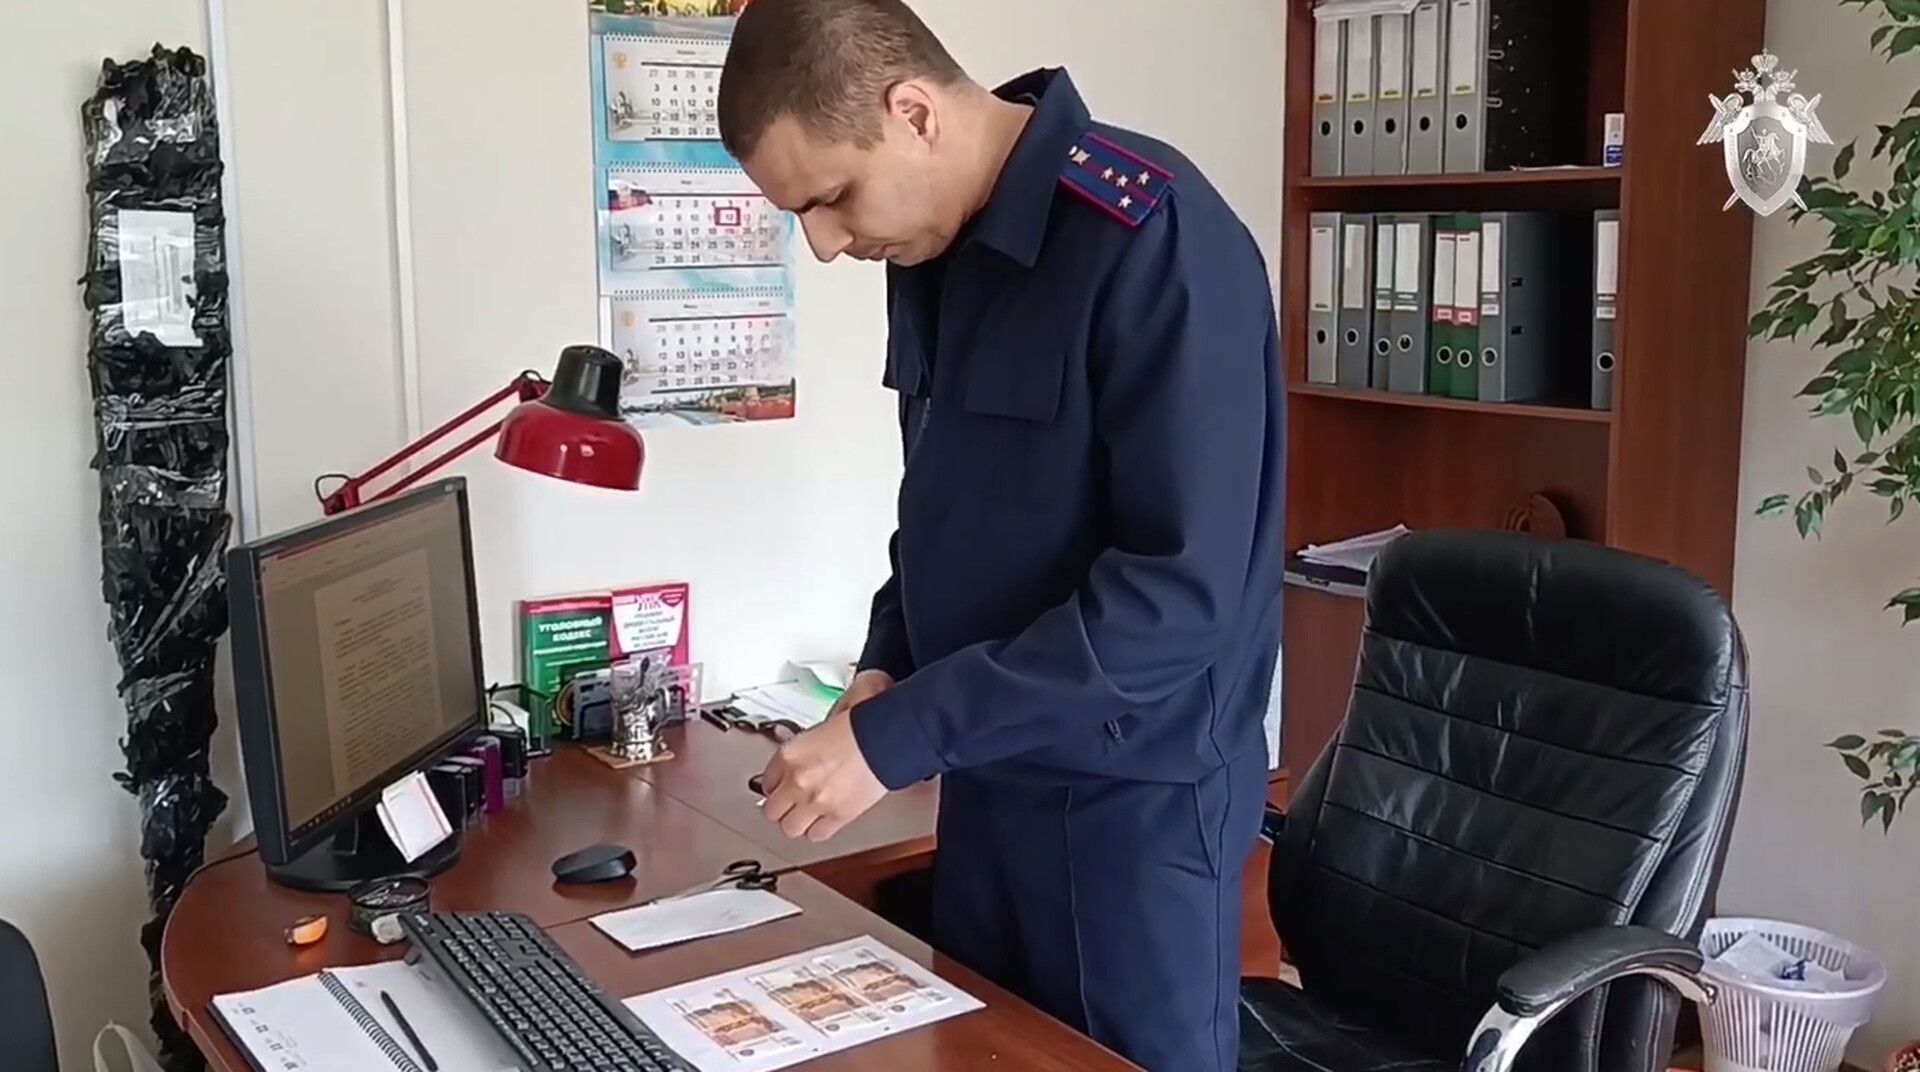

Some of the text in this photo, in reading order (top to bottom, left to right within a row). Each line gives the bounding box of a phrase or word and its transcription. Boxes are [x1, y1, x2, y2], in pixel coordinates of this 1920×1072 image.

[649, 69, 658, 78] 27
[655, 83, 660, 92] 3
[673, 84, 678, 92] 4
[691, 84, 696, 93] 5
[651, 98, 714, 107] 10 11 12 13
[653, 112, 660, 120] 17
[688, 113, 697, 121] 19
[652, 127, 715, 135] 24 25 26 27
[676, 200, 681, 208] 2
[655, 242, 664, 250] 22
[673, 242, 683, 250] 23
[691, 241, 700, 249] 24
[708, 241, 717, 249] 25
[725, 241, 735, 249] 26
[743, 241, 752, 249] 27
[656, 256, 665, 264] 29
[731, 322, 735, 330] 2
[662, 338, 666, 346] 5
[659, 352, 667, 360] 12
[676, 365, 685, 373] 20
[694, 364, 702, 372] 21
[711, 363, 720, 371] 22
[728, 362, 737, 370] 23
[676, 378, 685, 386] 27
[711, 376, 720, 384] 29
[538, 615, 603, 632] УГОЛОВНЫЙ
[552, 629, 592, 642] КОДЕКС
